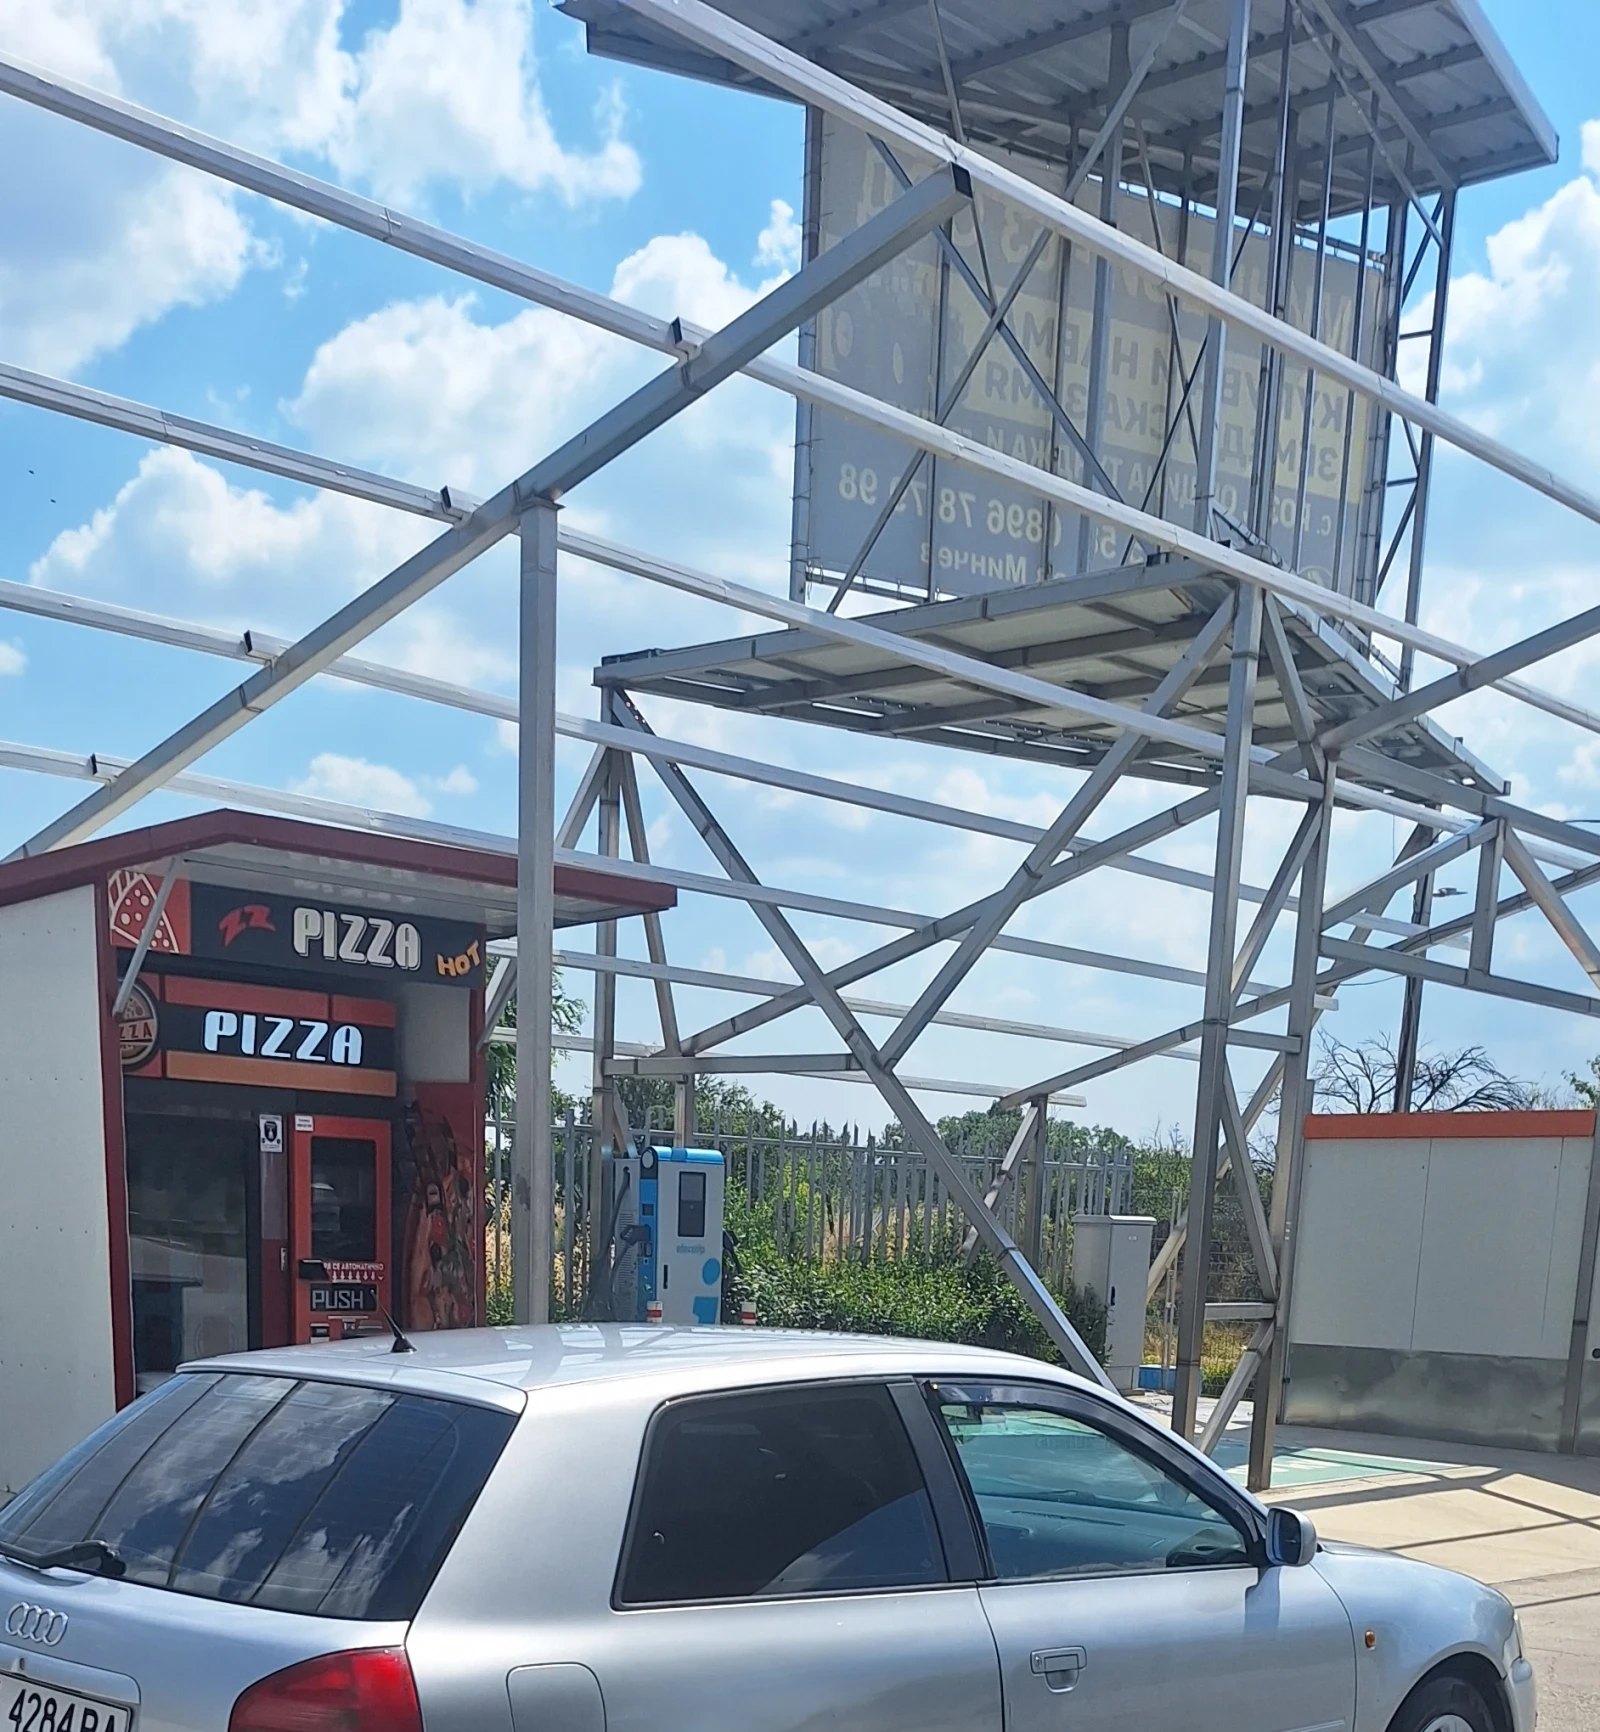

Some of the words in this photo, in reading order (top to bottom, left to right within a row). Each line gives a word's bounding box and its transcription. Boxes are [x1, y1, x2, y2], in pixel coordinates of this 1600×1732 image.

[292, 906, 421, 971] PIZZA
[436, 940, 482, 977] HOT
[119, 1021, 153, 1039] ZZA
[203, 1010, 362, 1065] PIZZA
[312, 1290, 364, 1309] PUSH
